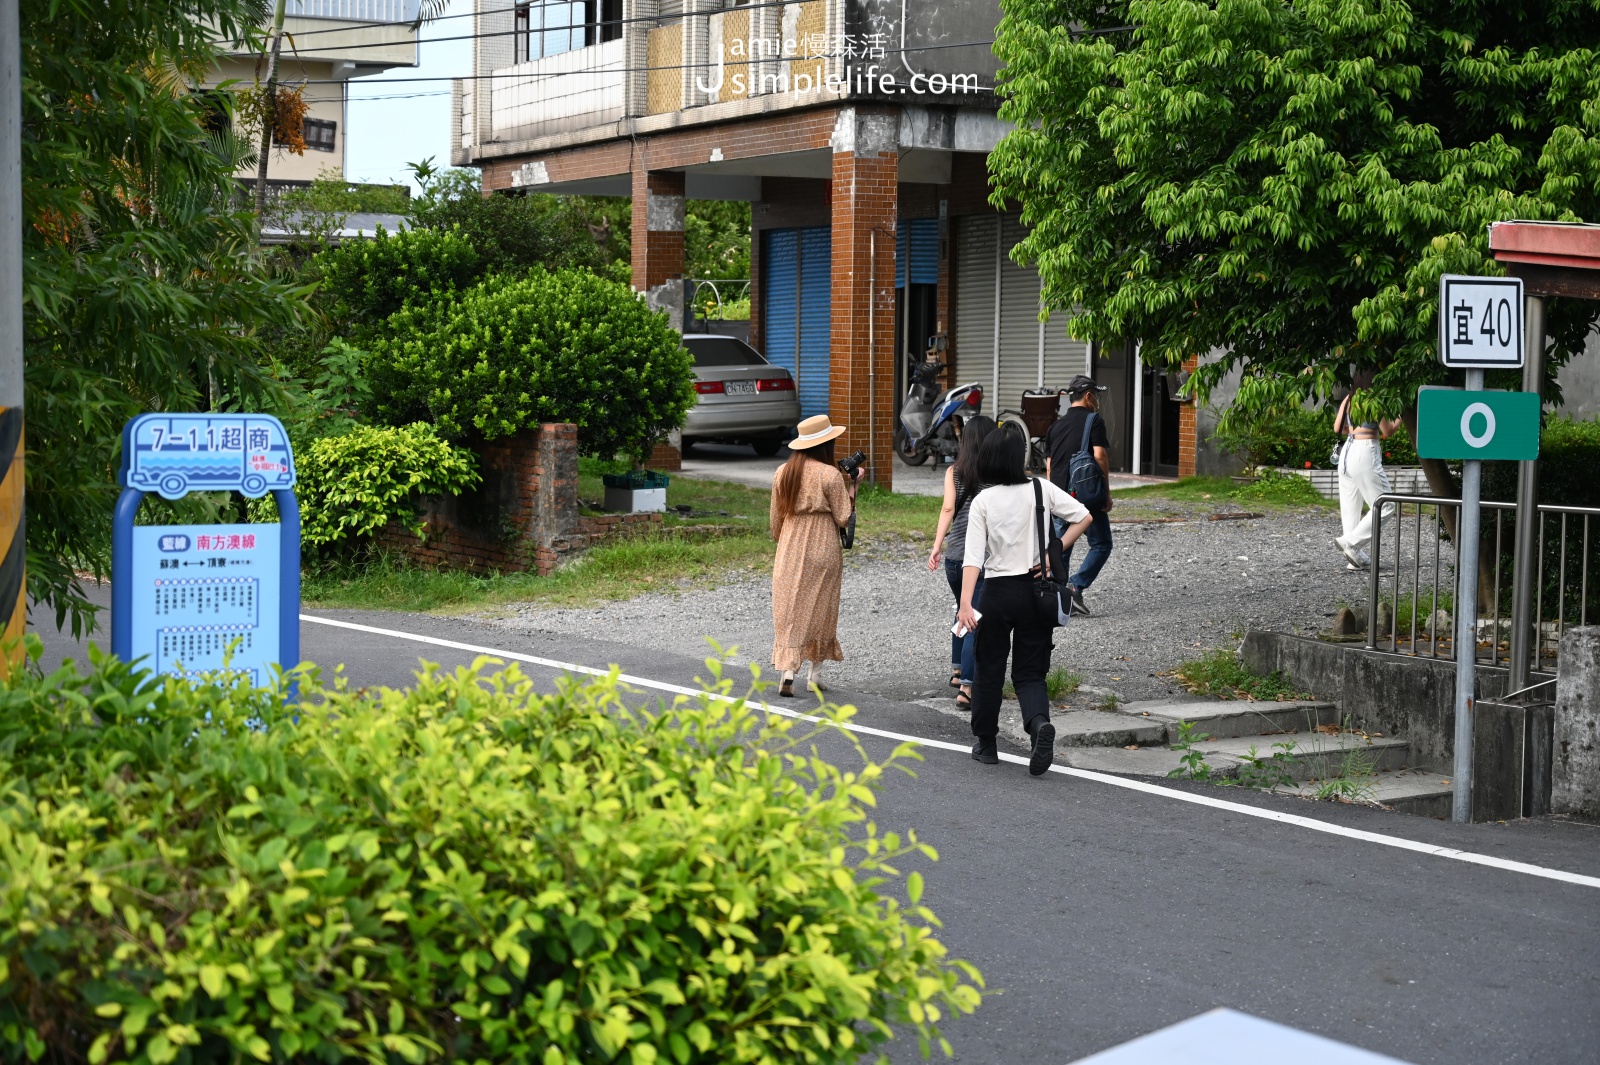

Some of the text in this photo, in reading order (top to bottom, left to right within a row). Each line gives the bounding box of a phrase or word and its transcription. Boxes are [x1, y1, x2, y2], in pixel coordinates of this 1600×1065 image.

[196, 534, 255, 551] 南方澳線
[160, 558, 180, 570] 蘇澳
